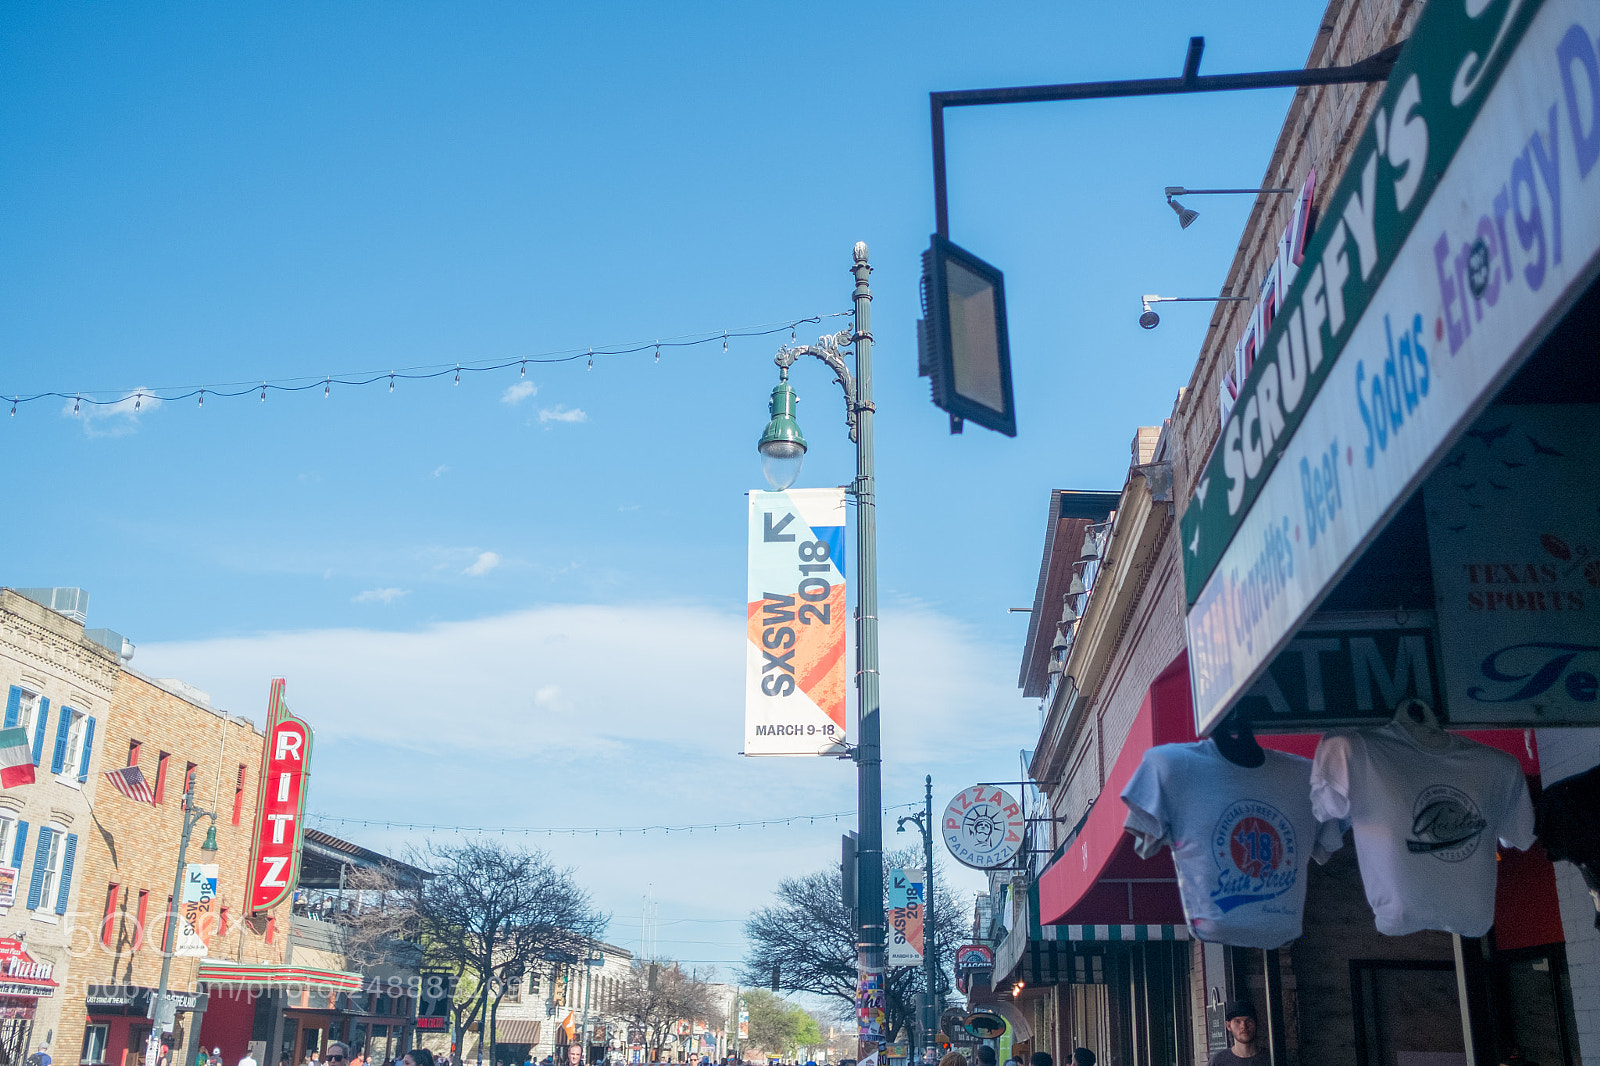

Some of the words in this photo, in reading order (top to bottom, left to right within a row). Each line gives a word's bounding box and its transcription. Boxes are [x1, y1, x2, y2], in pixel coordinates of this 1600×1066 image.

[1224, 72, 1429, 516] SCRUFFY'S
[1300, 435, 1343, 549] Beer
[1355, 311, 1430, 469] Sodas
[1433, 101, 1563, 358] Energy
[1556, 22, 1600, 182] D
[798, 540, 831, 626] 2018
[1463, 563, 1557, 585] TEXAS
[1466, 590, 1585, 612] SPORTS
[761, 592, 795, 697] SXSW
[1466, 641, 1600, 703] Te
[755, 724, 804, 737] MARCH
[258, 730, 304, 888] RITZ
[946, 787, 1024, 843] PIZZARIA
[1216, 806, 1245, 847] OFFICIAL
[1243, 803, 1278, 821] STREET
[948, 835, 1014, 865] PAPARAZZI
[198, 882, 212, 913] 2018
[1209, 867, 1251, 898] Sixth
[1253, 862, 1299, 893] Street
[183, 899, 199, 937] SXSW
[906, 887, 918, 920] 2018
[894, 906, 906, 945] SXSW
[8, 956, 53, 979] PIZZERIA
[32, 986, 52, 996] Garden
